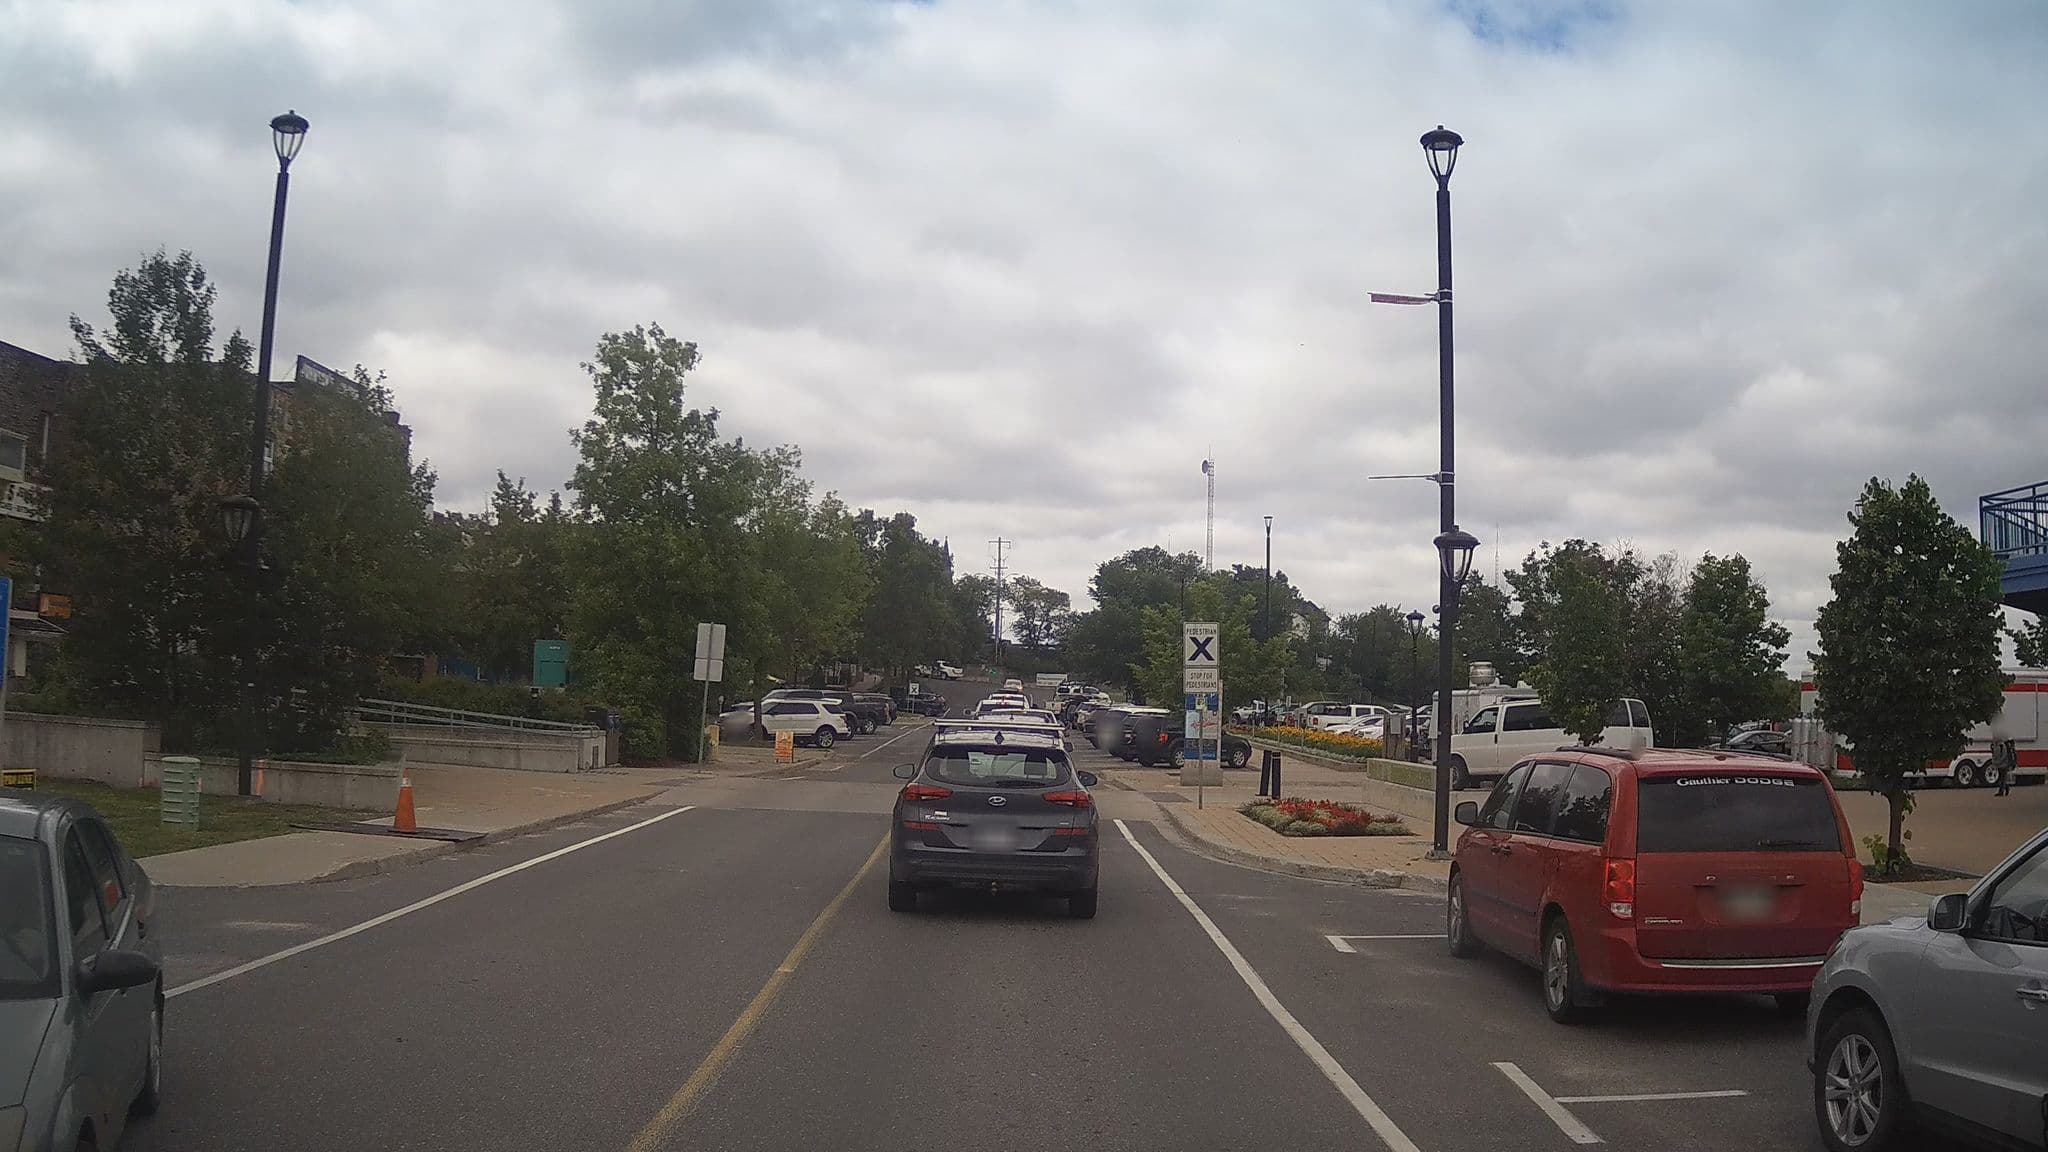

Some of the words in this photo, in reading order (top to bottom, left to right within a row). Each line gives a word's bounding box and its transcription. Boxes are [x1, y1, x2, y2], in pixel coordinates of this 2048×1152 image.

[1188, 637, 1215, 661] X
[1677, 777, 1731, 786] Gauthier
[1735, 777, 1794, 786] DODGE
